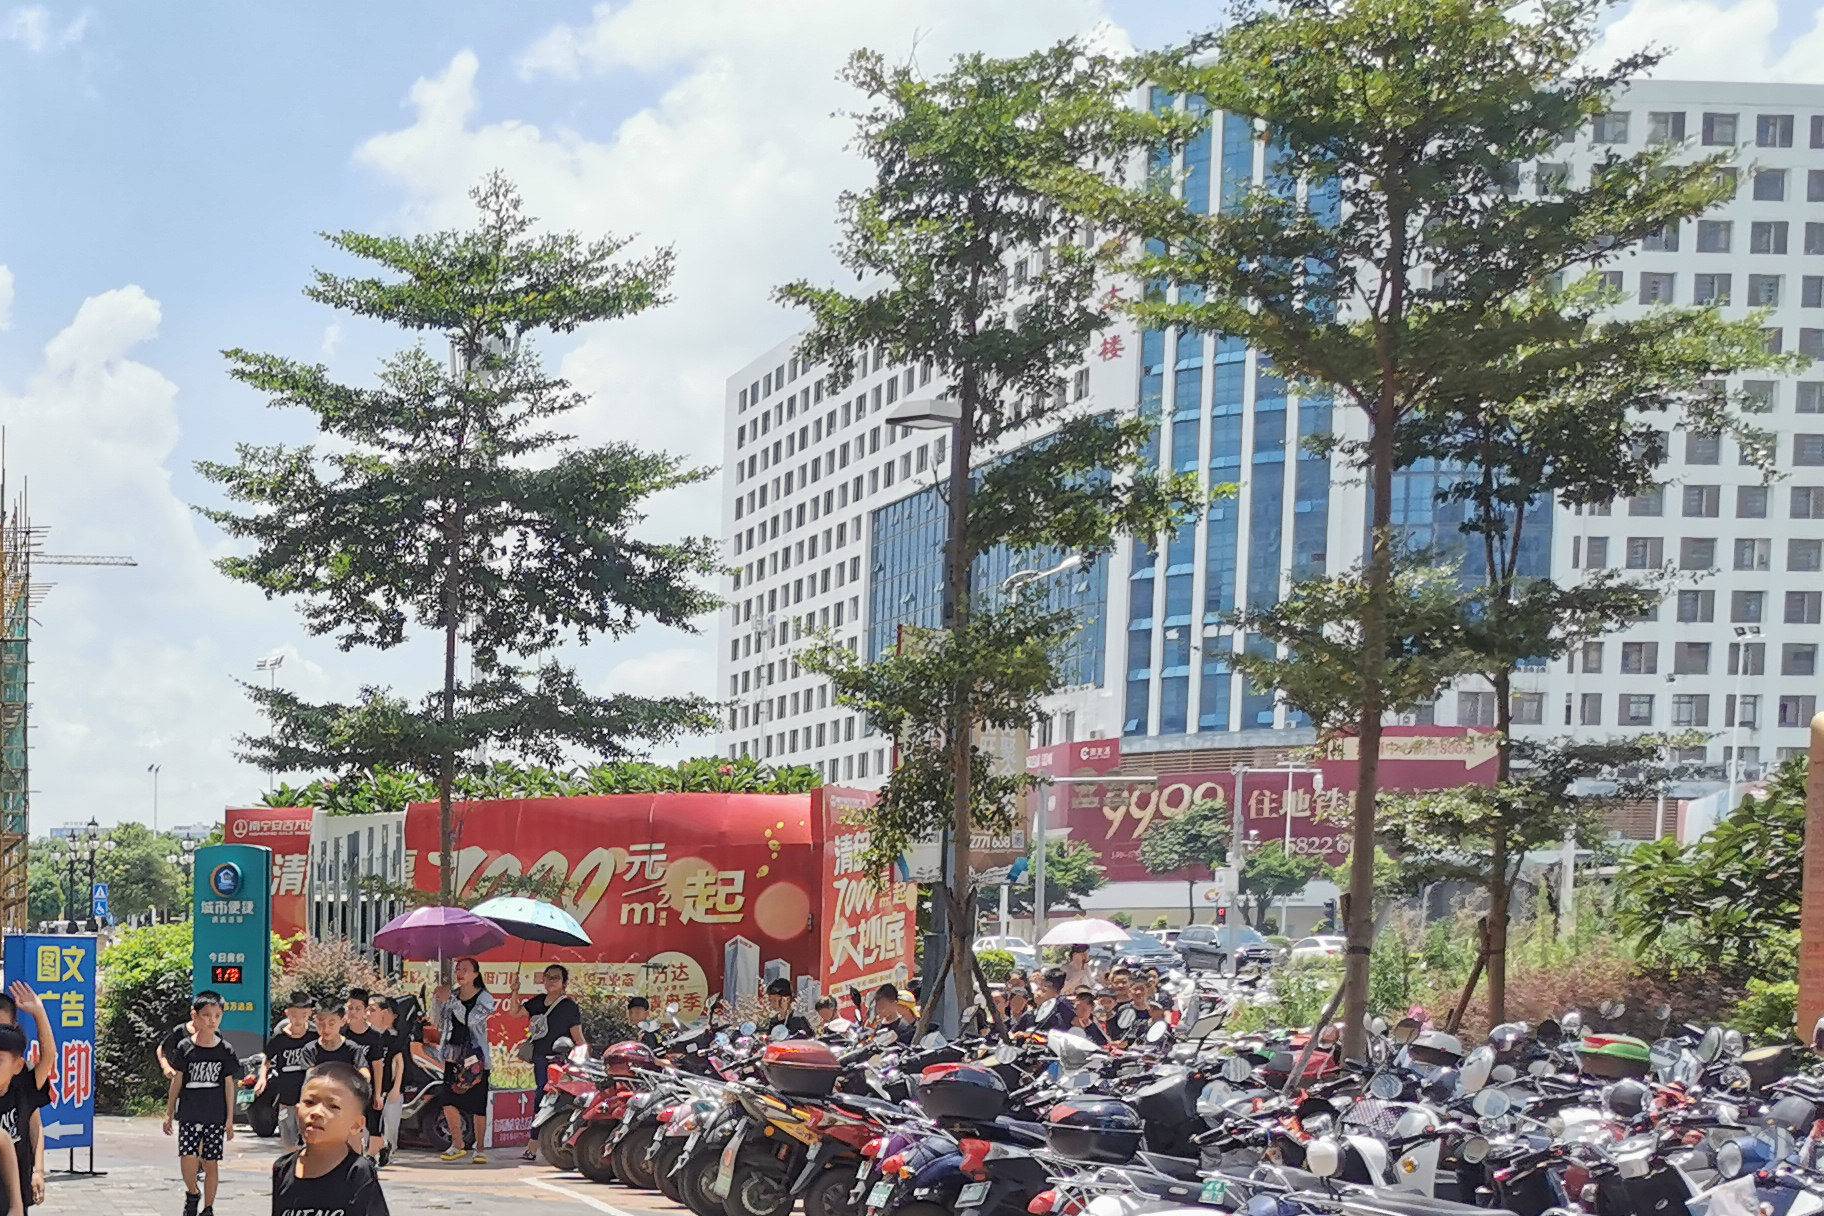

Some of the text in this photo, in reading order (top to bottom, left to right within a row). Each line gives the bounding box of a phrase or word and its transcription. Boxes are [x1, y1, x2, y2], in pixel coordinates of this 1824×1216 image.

[271, 854, 307, 896] 清
[624, 843, 667, 880] 元
[679, 870, 745, 926] 起
[830, 911, 906, 974] 大抄底
